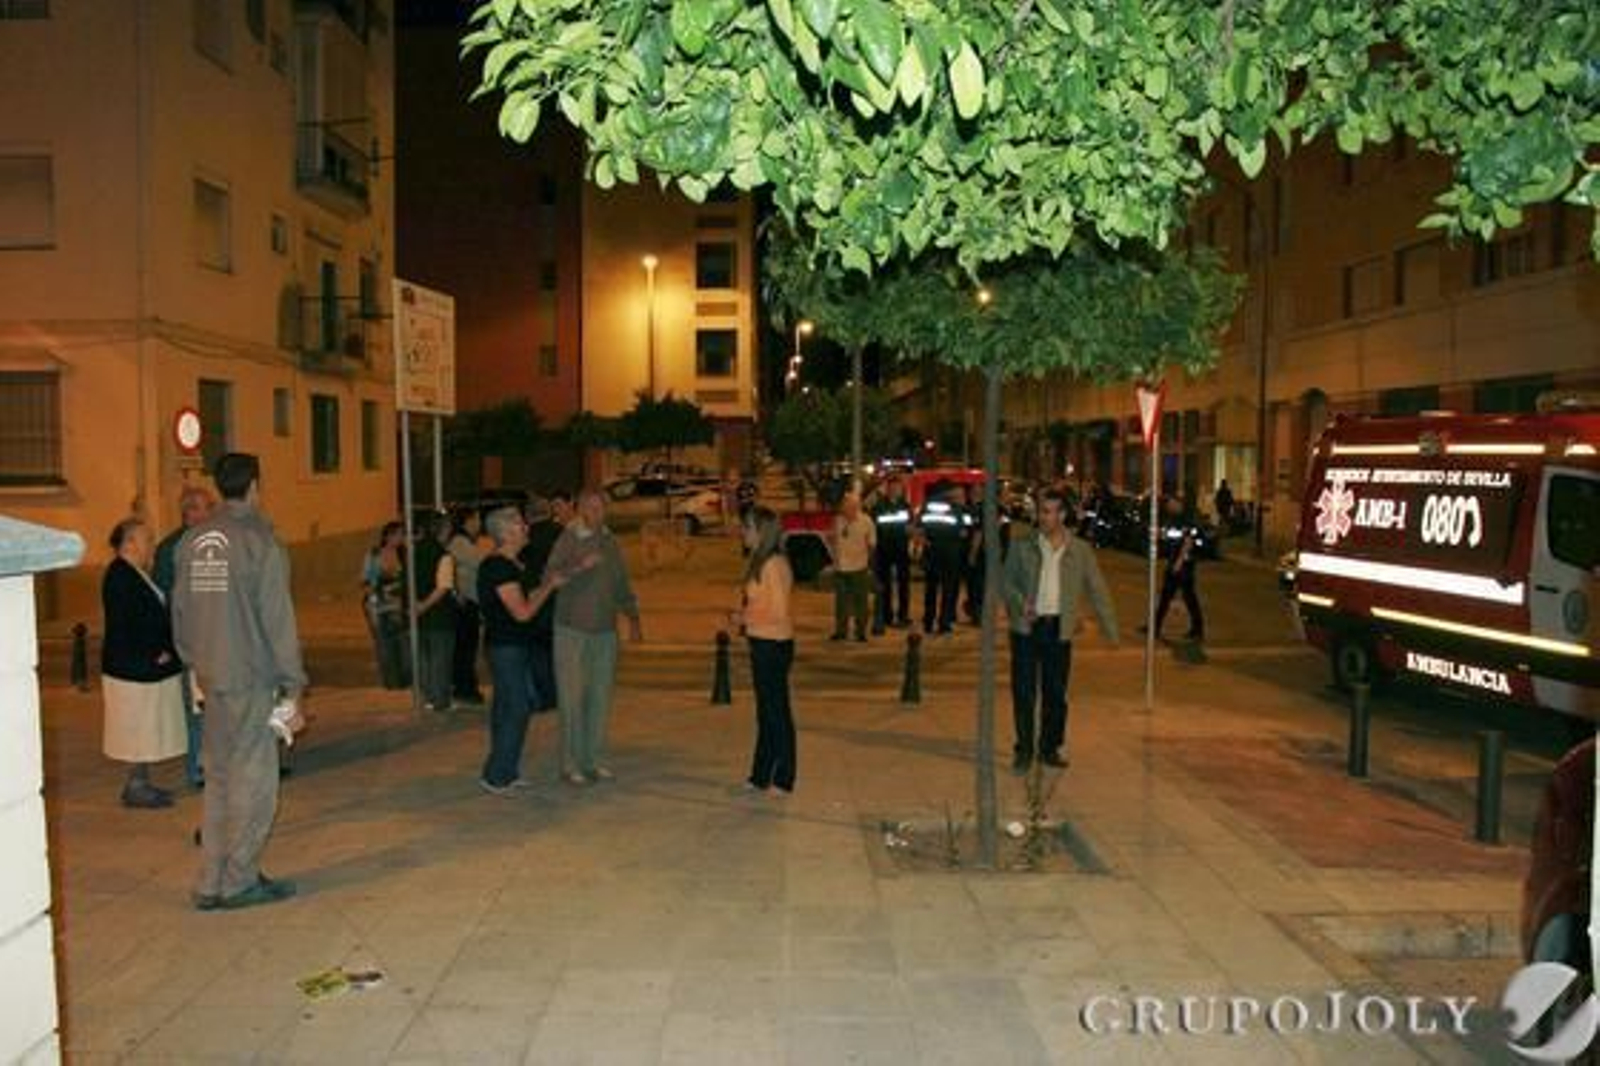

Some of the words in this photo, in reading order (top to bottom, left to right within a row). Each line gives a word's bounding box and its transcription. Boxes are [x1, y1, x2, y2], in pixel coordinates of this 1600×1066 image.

[1447, 471, 1462, 486] DE
[1464, 472, 1512, 488] SEVILLA
[1406, 652, 1512, 696] AMBULANCIA
